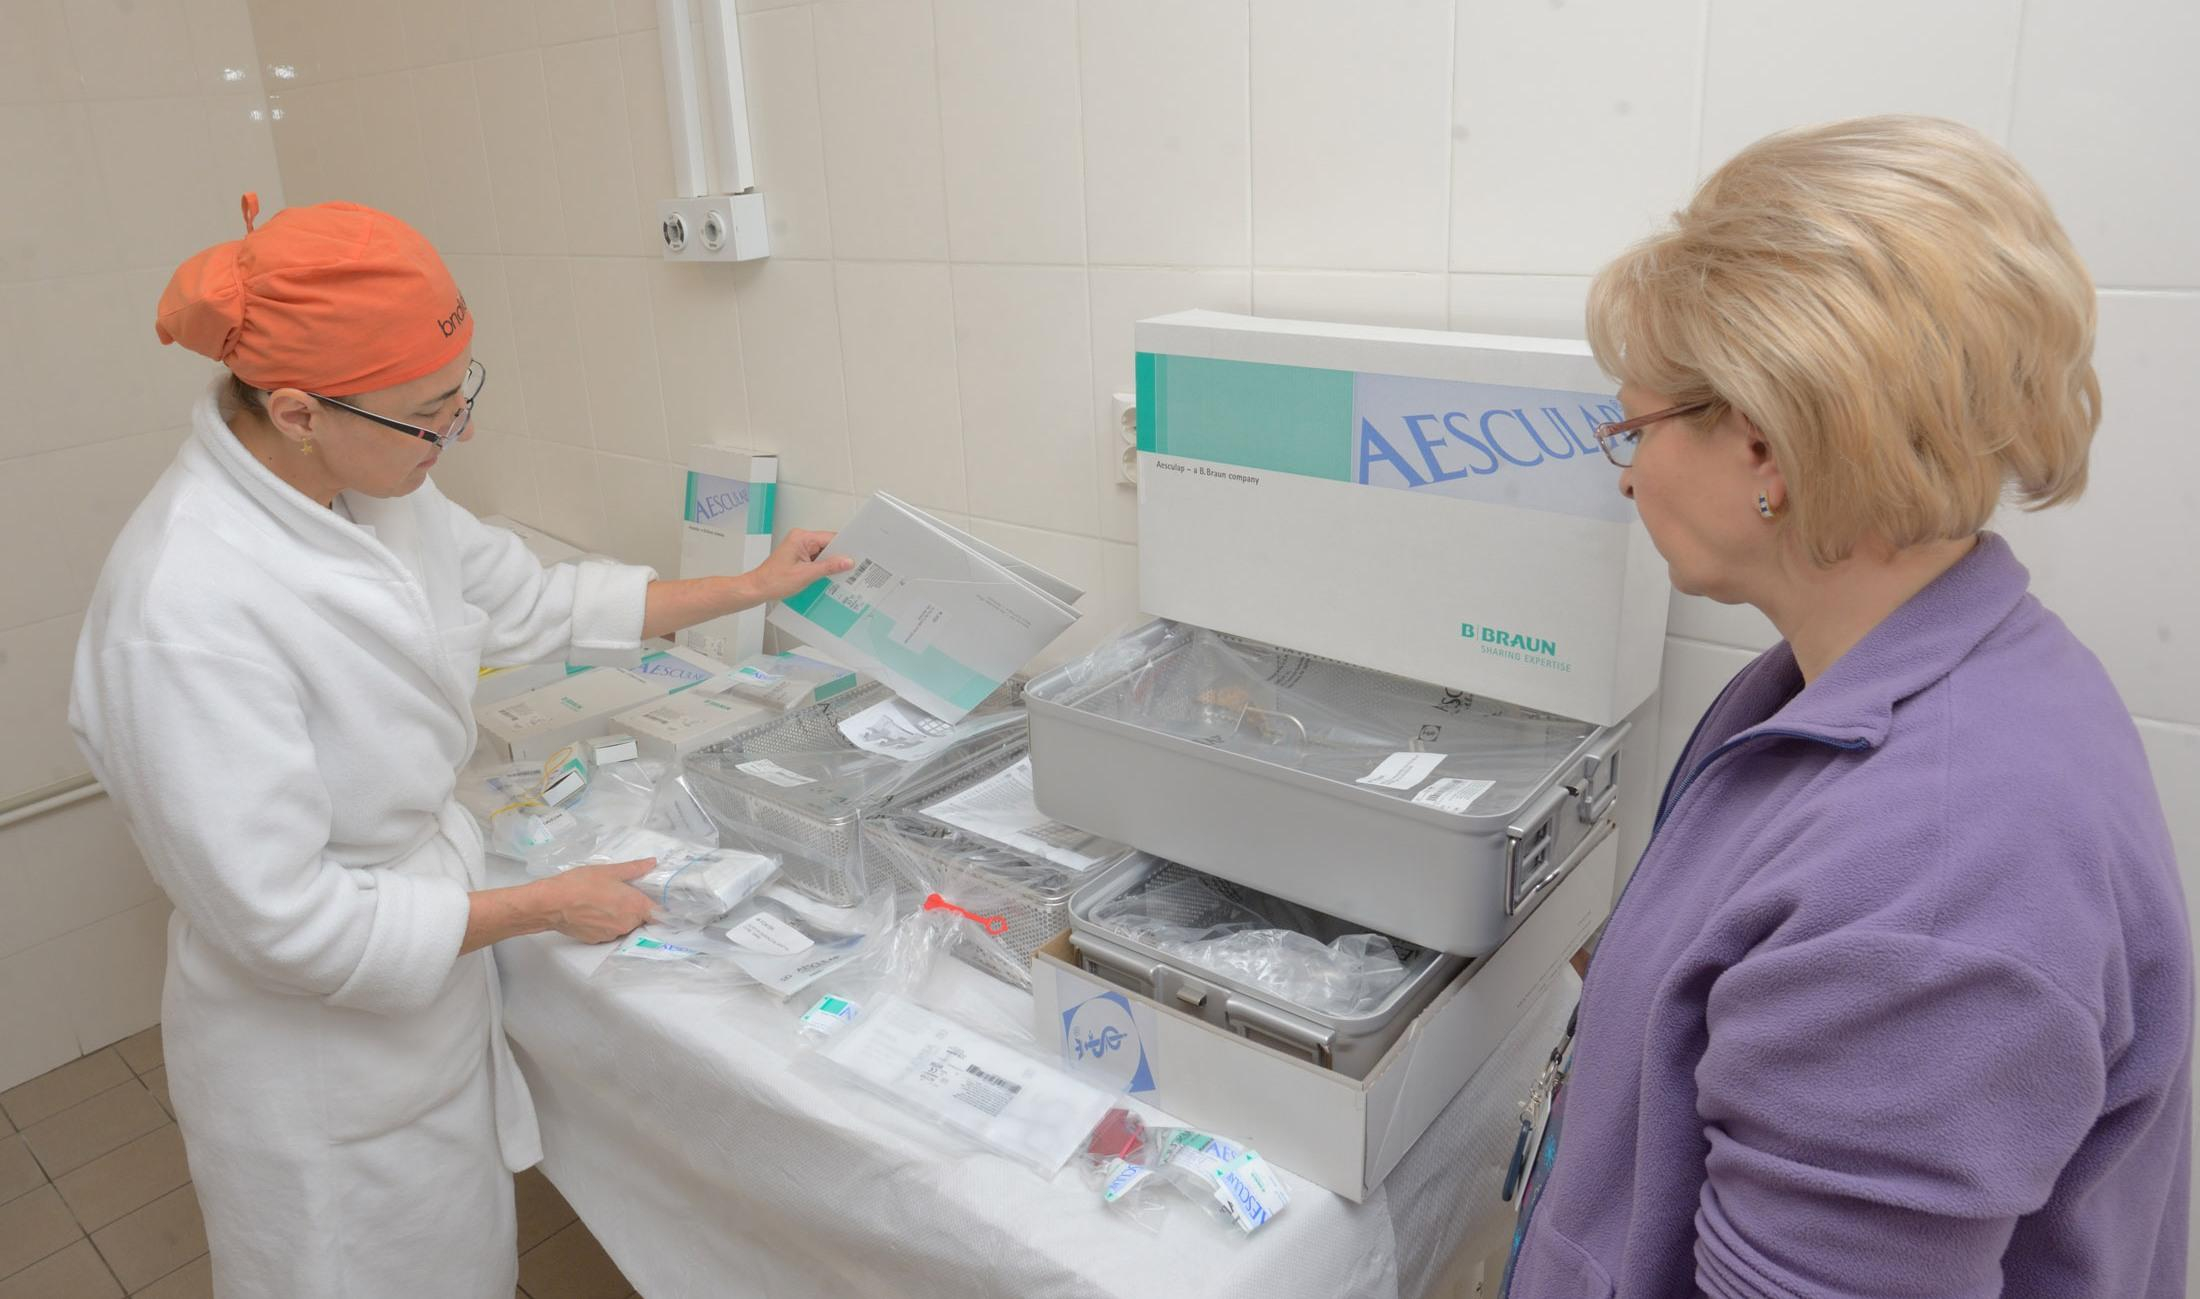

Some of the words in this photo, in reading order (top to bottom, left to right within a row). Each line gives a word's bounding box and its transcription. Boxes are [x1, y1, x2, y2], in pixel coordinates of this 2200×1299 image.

[1156, 460, 1185, 474] Aesculap
[1228, 472, 1260, 486] company
[1481, 626, 1557, 657] BRAUN
[1480, 645, 1521, 661] SHARING
[1524, 654, 1571, 672] EXPERTISE
